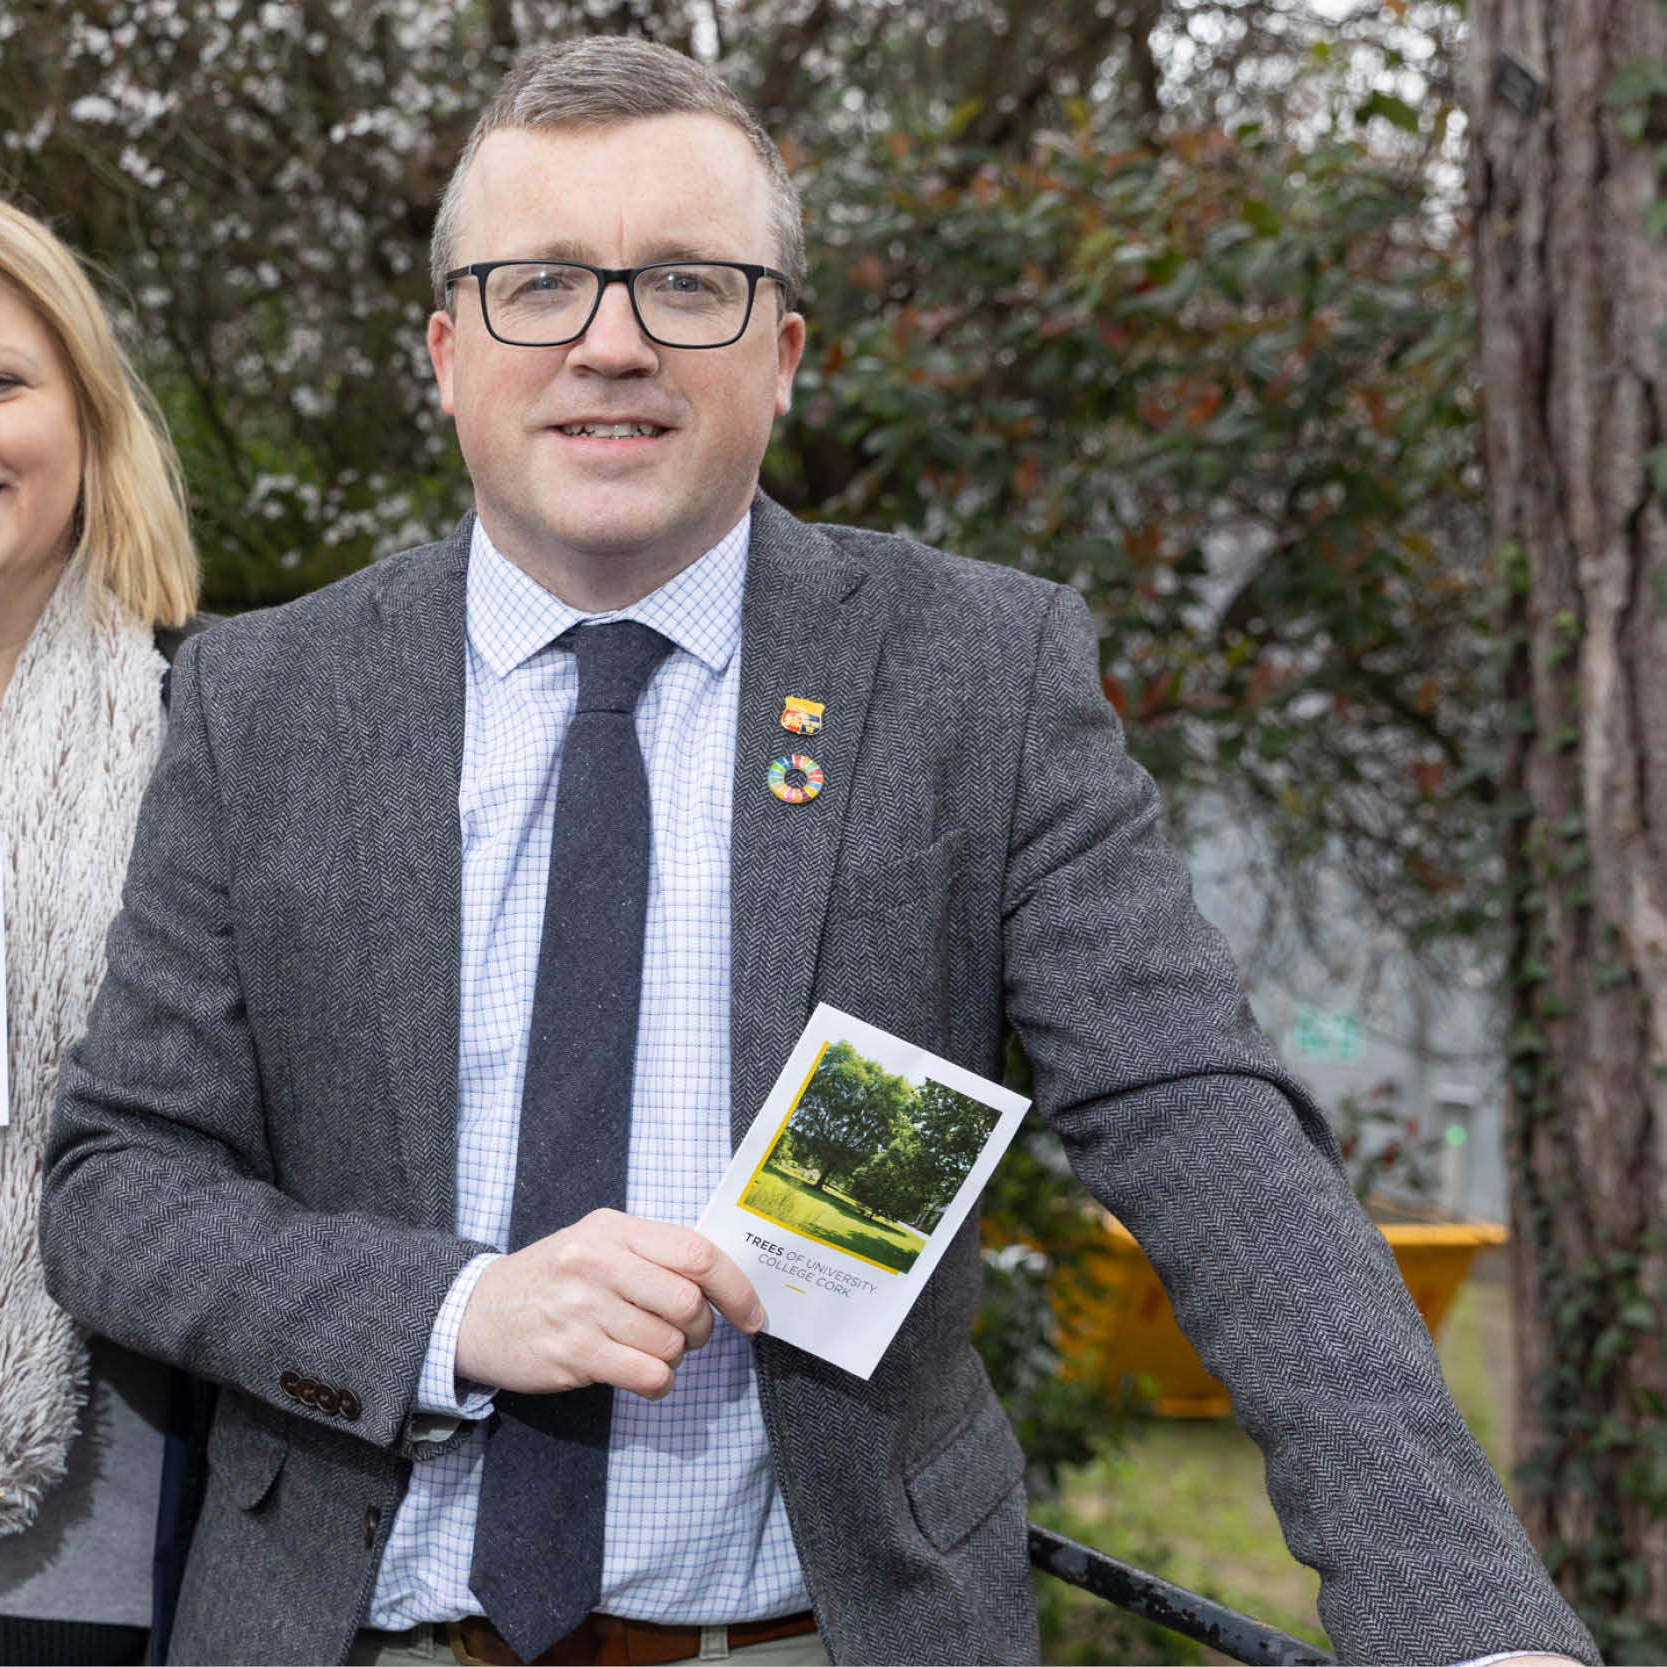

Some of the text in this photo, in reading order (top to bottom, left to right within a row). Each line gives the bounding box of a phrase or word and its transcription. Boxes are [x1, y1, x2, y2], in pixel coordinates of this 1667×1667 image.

[743, 1232, 879, 1293] TREES OF UNIVERSITY
[758, 1253, 852, 1298] COLLEGE CORK
